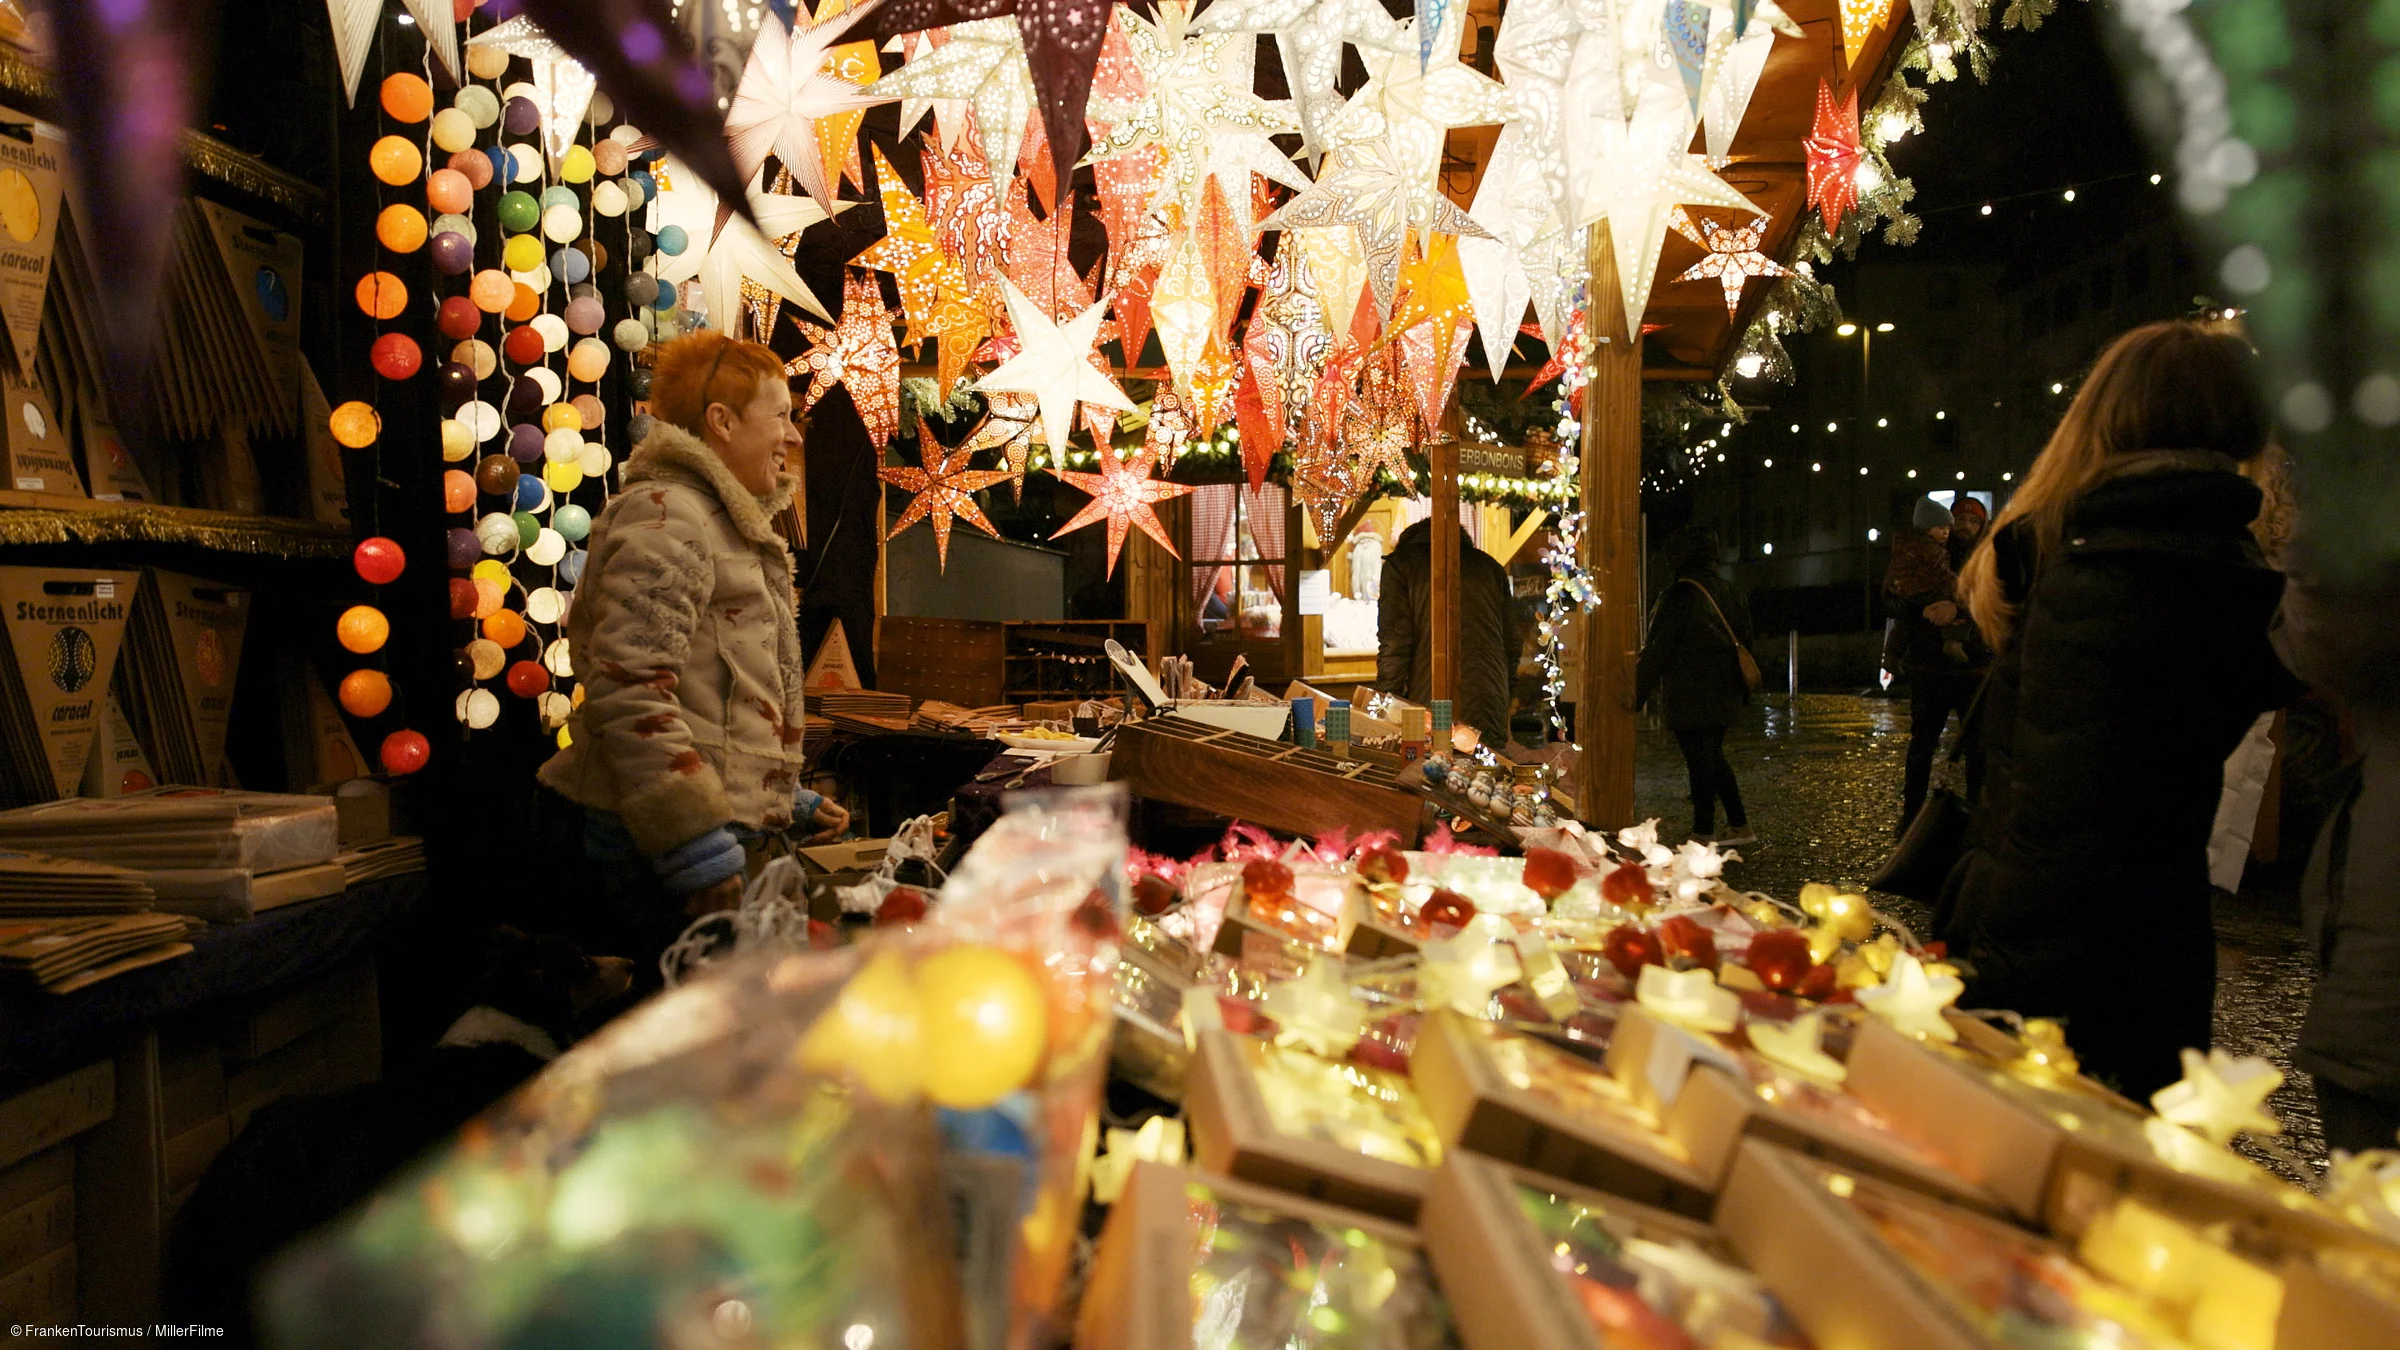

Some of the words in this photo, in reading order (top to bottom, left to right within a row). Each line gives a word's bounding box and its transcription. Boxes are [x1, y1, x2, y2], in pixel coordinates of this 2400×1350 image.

[1, 251, 45, 274] caracol
[16, 600, 124, 621] Sternenlicht
[52, 700, 93, 722] caracol
